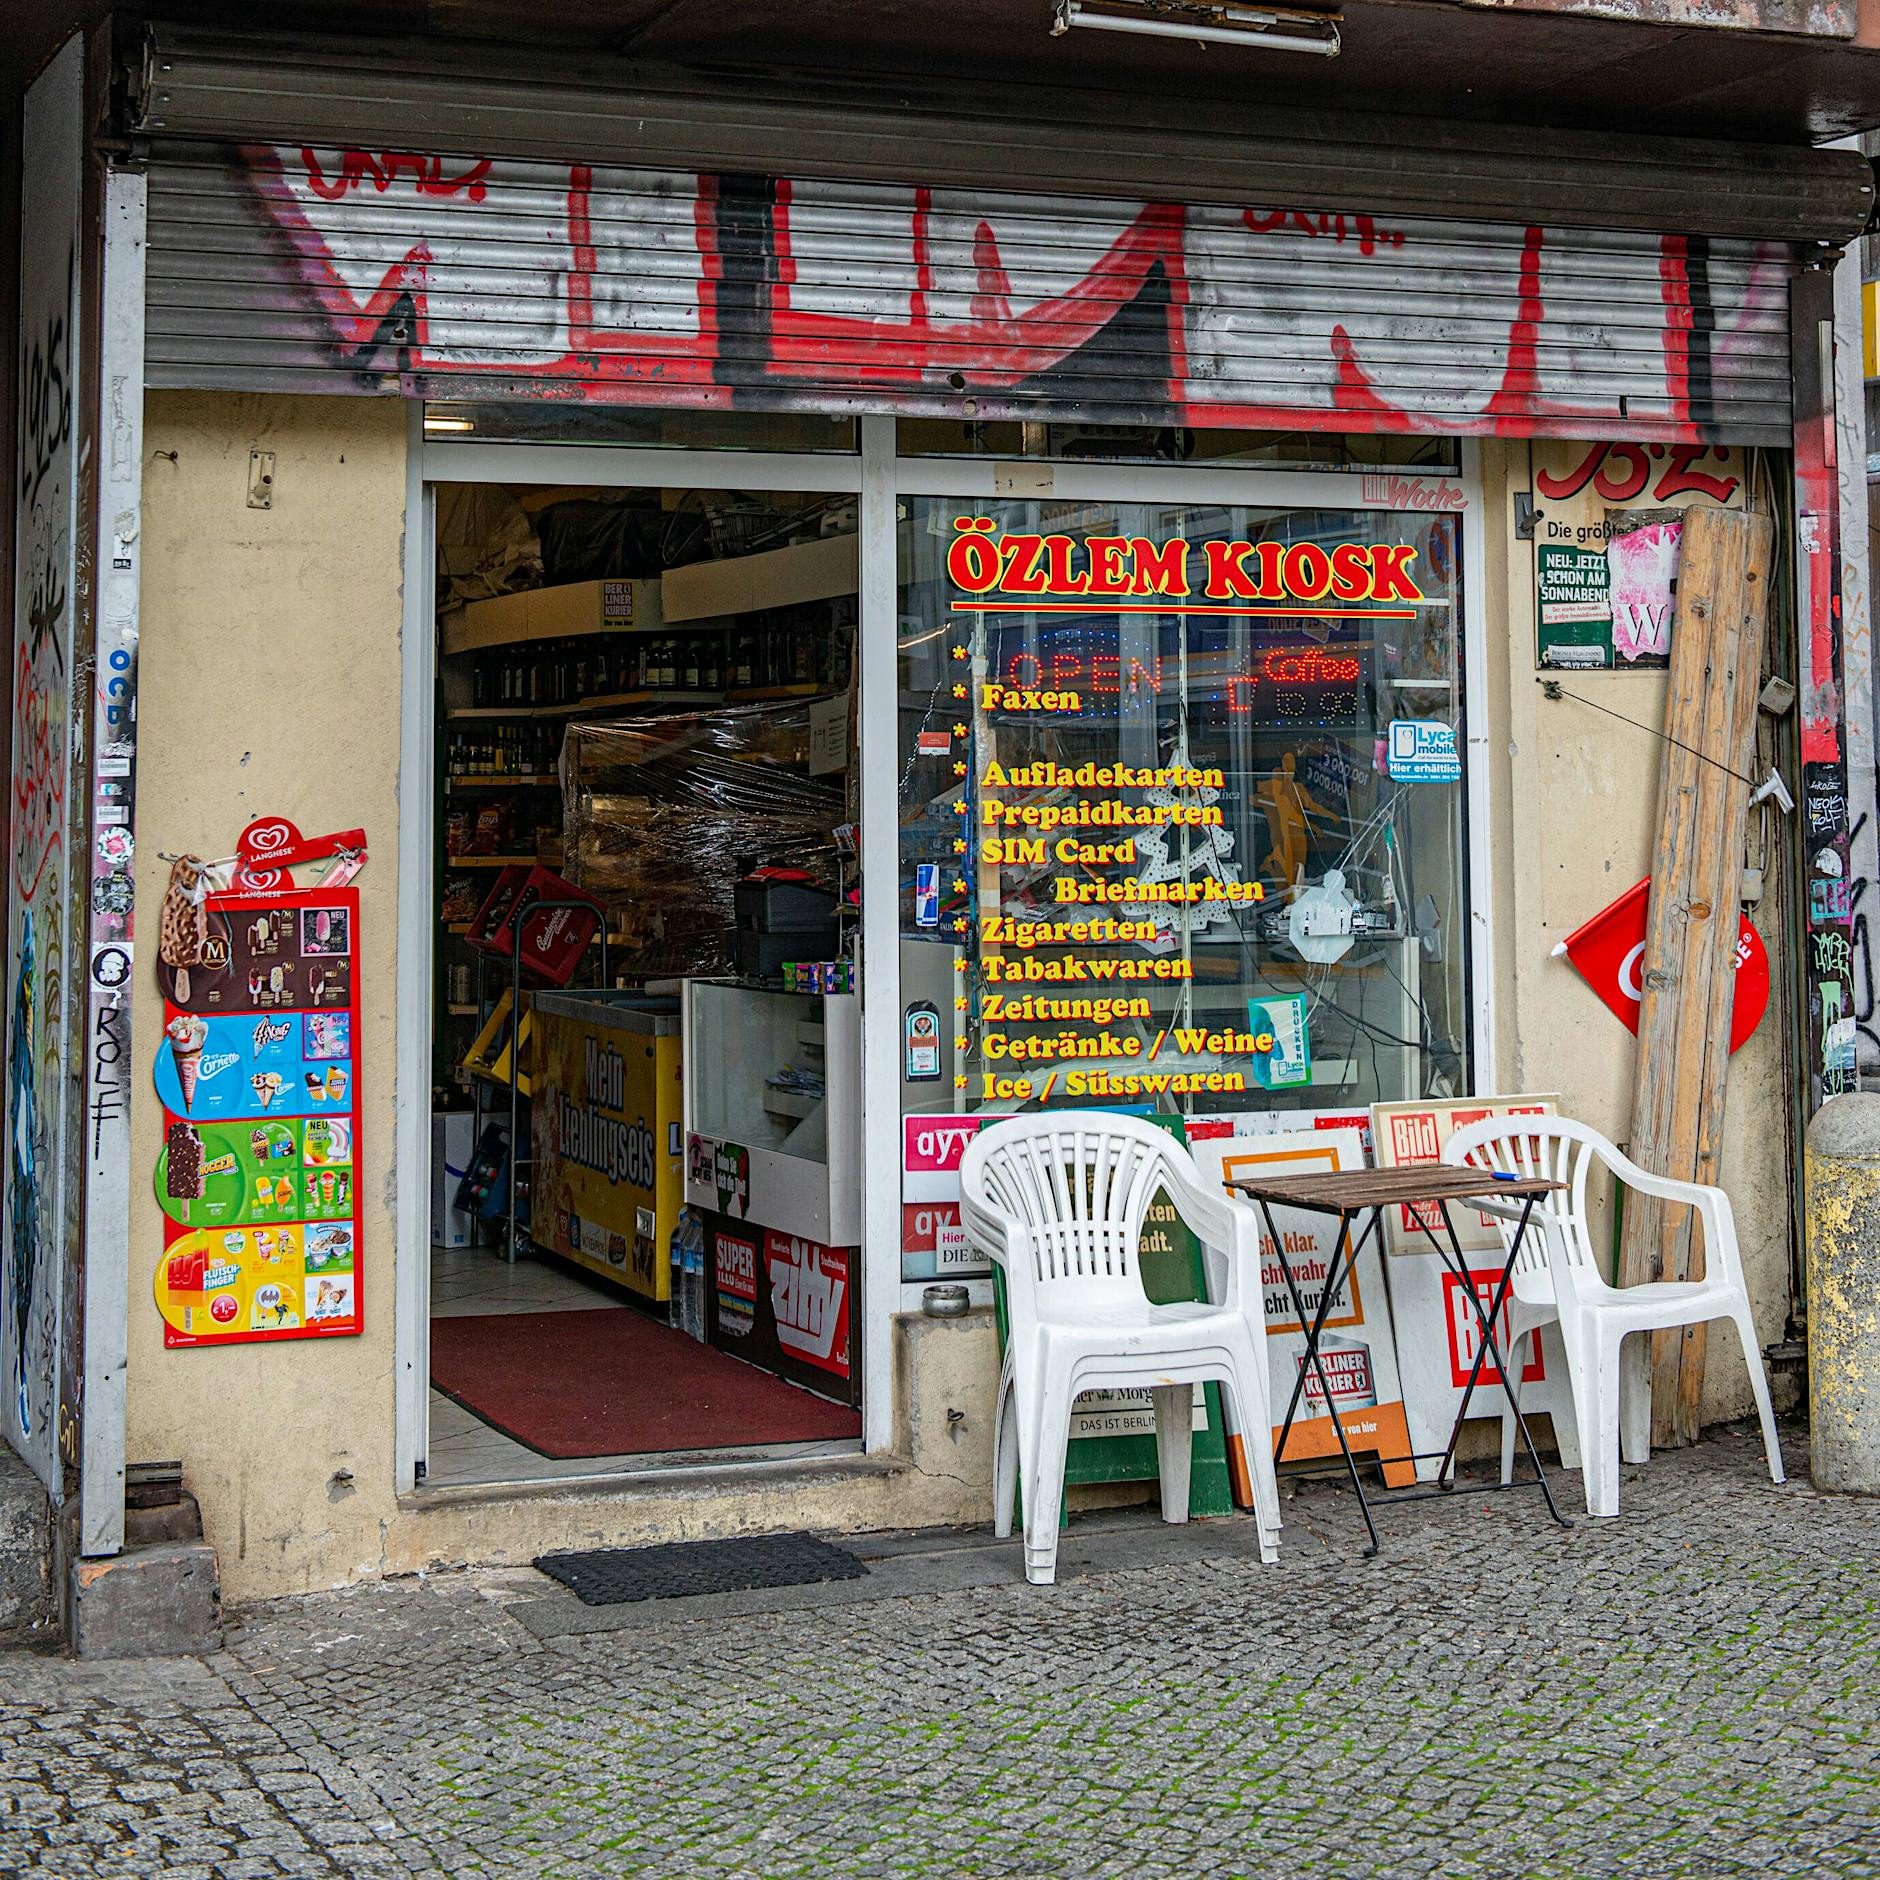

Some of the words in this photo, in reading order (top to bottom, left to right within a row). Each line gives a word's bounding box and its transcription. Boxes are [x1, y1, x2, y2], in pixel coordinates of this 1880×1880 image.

[1389, 475, 1469, 509] Woche
[1547, 521, 1572, 538] Die
[947, 516, 1190, 597] ÖZLEM
[1203, 538, 1424, 602] KIOSK
[1546, 554, 1573, 568] NEU:
[1573, 555, 1606, 570] JETZT
[1546, 570, 1585, 585] SCHON
[1587, 571, 1606, 586] AM
[1541, 586, 1610, 602] SONNABEND
[1010, 654, 1162, 693] OPEN
[1263, 648, 1360, 683] Coffee
[981, 683, 1082, 715] Faxen
[1418, 728, 1457, 745] Lyca
[1418, 744, 1457, 754] mobile
[981, 760, 1226, 791] Aufladekarten
[1390, 763, 1412, 773] Hier
[1414, 763, 1462, 773] erhältlich
[981, 799, 1224, 830] Prepaidkarten
[981, 838, 1047, 866] SIM
[1055, 838, 1137, 866] Card
[1055, 876, 1265, 905] Briefmarken
[981, 915, 1158, 945] Zigaretten
[981, 953, 1194, 982] Tabakwaren
[981, 993, 1152, 1023] Zeitungen
[981, 1031, 1141, 1062] Getränke
[1148, 1029, 1167, 1059] /
[1174, 1028, 1274, 1055] Weine
[197, 1053, 241, 1081] Cornetto
[585, 1035, 624, 1112] Mein
[981, 1072, 1033, 1101] Ice
[1040, 1070, 1059, 1100] /
[1065, 1069, 1246, 1099] Süsswaren
[310, 1121, 328, 1129] NEU
[1392, 1117, 1438, 1157] Bild
[559, 1092, 655, 1191] Lieblingseis
[942, 1232, 965, 1244] Hier
[1283, 1231, 1319, 1254] klar.
[716, 1238, 754, 1279] SUPER
[943, 1248, 969, 1264] DIE
[203, 1275, 236, 1291] FINGER
[717, 1270, 735, 1287] ILLU
[1261, 1263, 1286, 1285] cht
[1080, 1418, 1102, 1431] DAS
[1105, 1417, 1119, 1429] IST
[1347, 1424, 1362, 1435] von
[1361, 1421, 1378, 1433] hier
